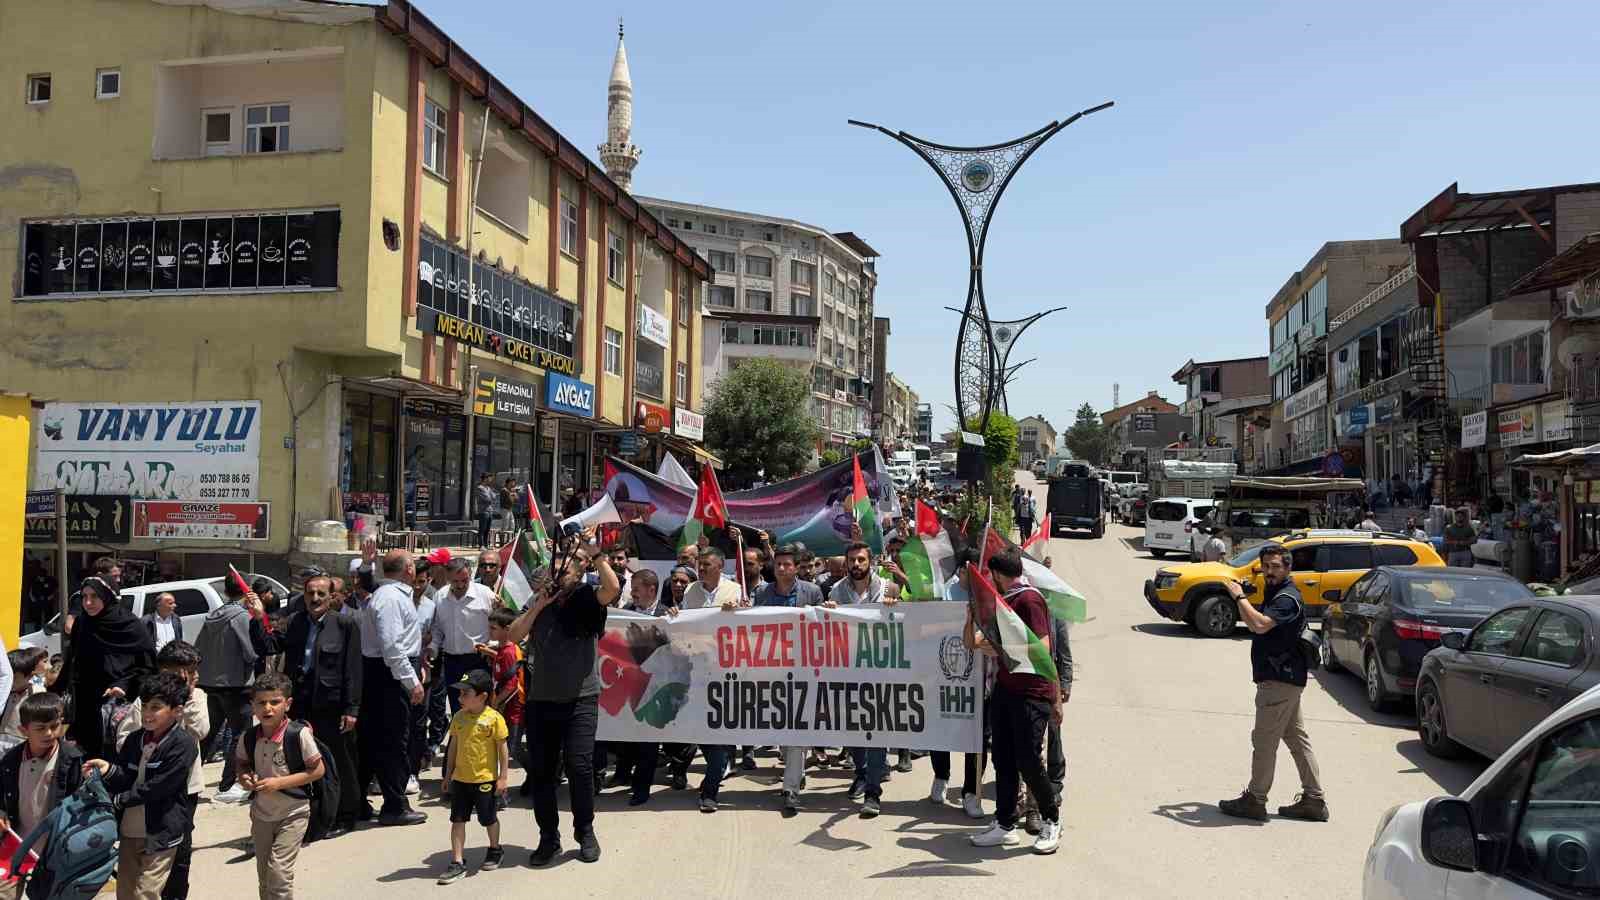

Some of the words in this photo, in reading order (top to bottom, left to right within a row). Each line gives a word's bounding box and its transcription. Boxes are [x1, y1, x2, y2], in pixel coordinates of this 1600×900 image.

[437, 314, 484, 345] MEKAN
[506, 338, 536, 361] OKEY
[540, 350, 576, 374] SALONU
[554, 380, 591, 410] AYGAZ
[76, 406, 257, 441] VANYOLU
[194, 442, 246, 454] Seyahat
[199, 473, 218, 484] 0530
[231, 473, 241, 484] 86
[241, 473, 250, 484] 05
[199, 487, 217, 498] 0535
[231, 487, 241, 498] 77
[241, 487, 250, 498] 70
[182, 503, 220, 512] GAMZE
[716, 622, 796, 669] GAZZE
[799, 612, 849, 678] İÇİN
[855, 612, 911, 670] ACİL
[706, 671, 809, 730] SÜRESİZ
[813, 680, 926, 742] ATEŞKES
